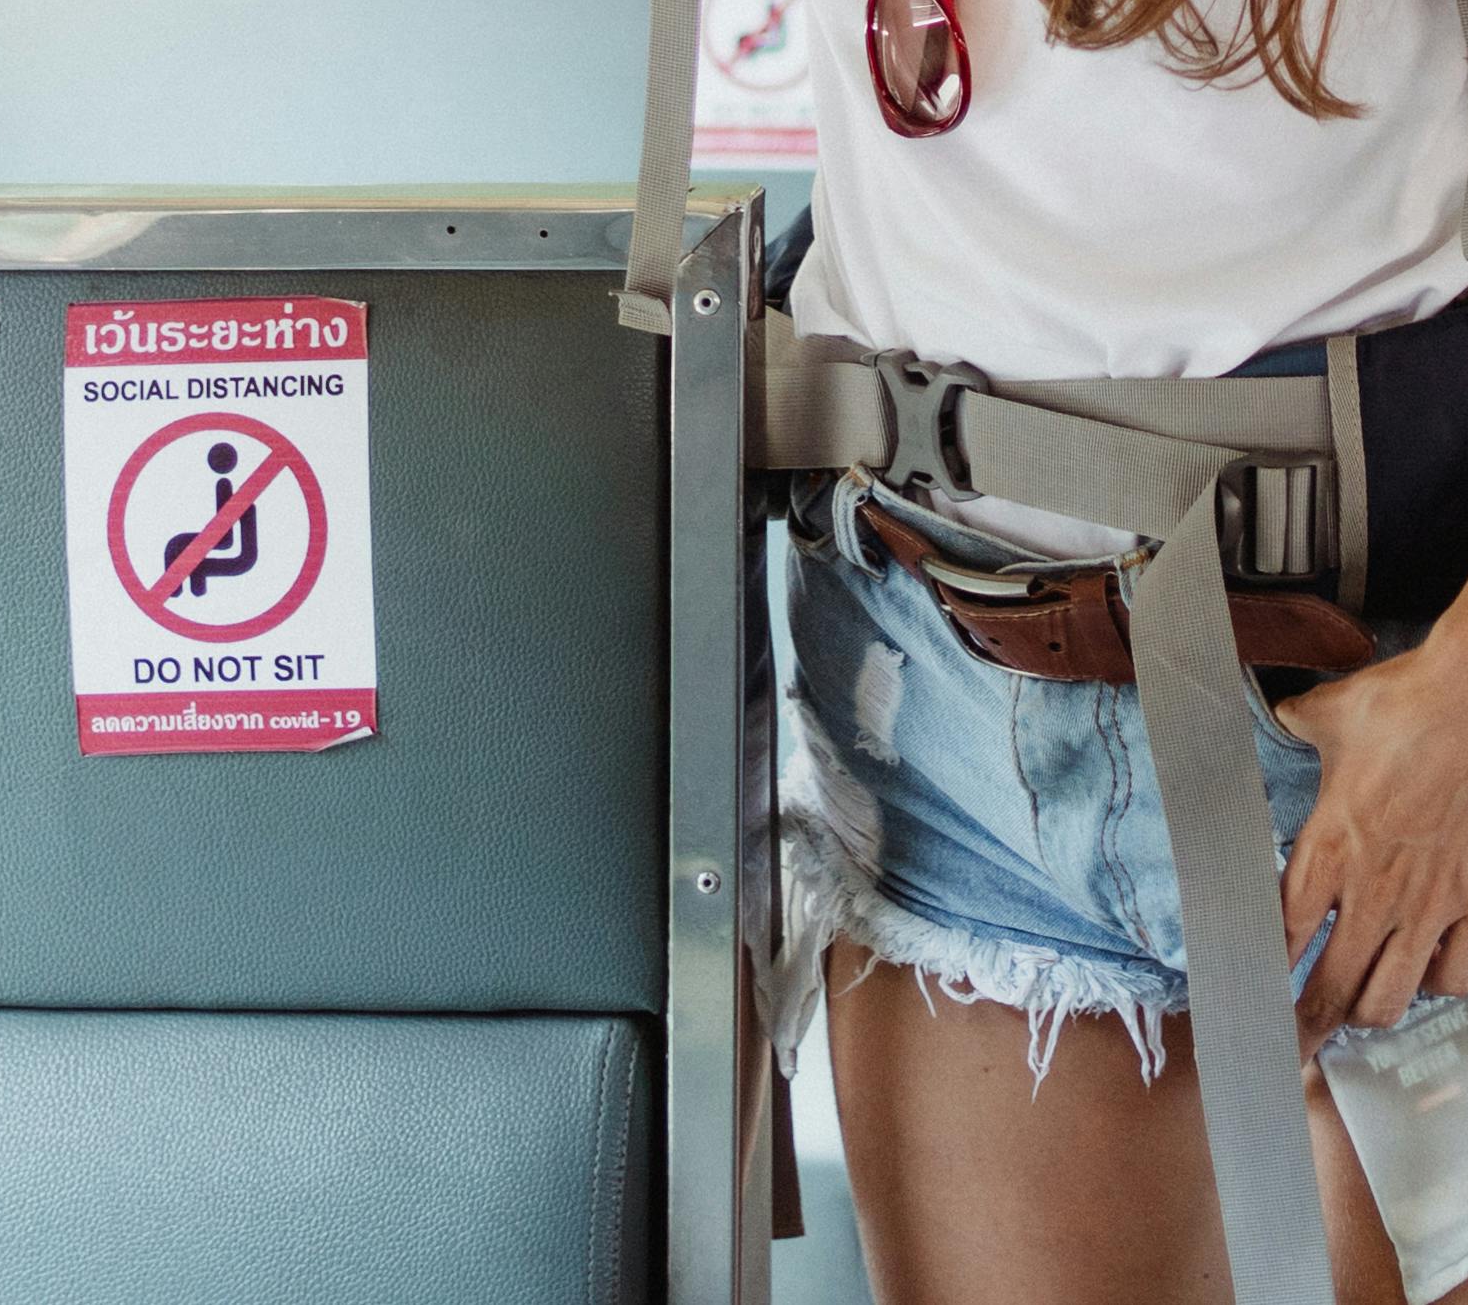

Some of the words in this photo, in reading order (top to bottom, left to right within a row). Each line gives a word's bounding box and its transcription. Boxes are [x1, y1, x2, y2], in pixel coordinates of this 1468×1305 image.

[84, 302, 348, 356] เว้นระยะห่าง
[84, 379, 179, 402] SOCIAL
[187, 374, 344, 399] DISTANCING
[133, 657, 181, 684] DO
[194, 655, 262, 683] NOT
[274, 654, 325, 681] SIT
[91, 701, 265, 733] ลดความเสี่ยงจาก
[269, 709, 361, 730] covid-19
